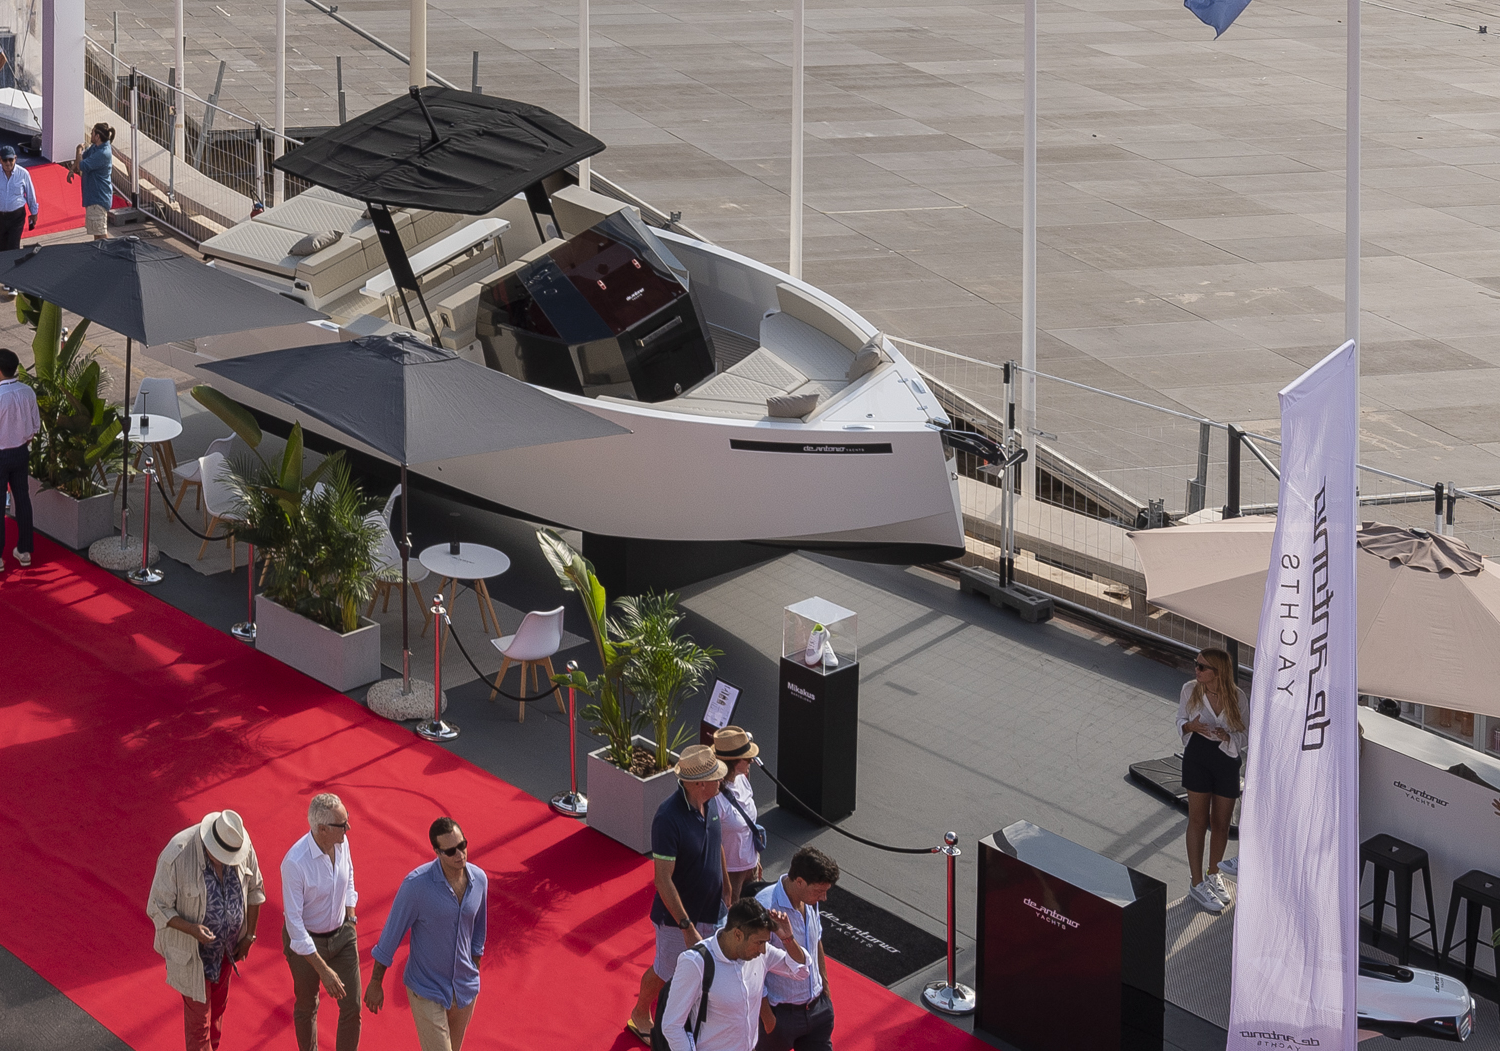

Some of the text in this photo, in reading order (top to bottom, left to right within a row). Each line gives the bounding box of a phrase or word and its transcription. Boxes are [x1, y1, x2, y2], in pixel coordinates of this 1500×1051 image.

[787, 681, 816, 701] Mikakus
[1405, 792, 1436, 809] YACHTS
[1035, 911, 1067, 930] YACHTS
[830, 922, 874, 948] YACHTS
